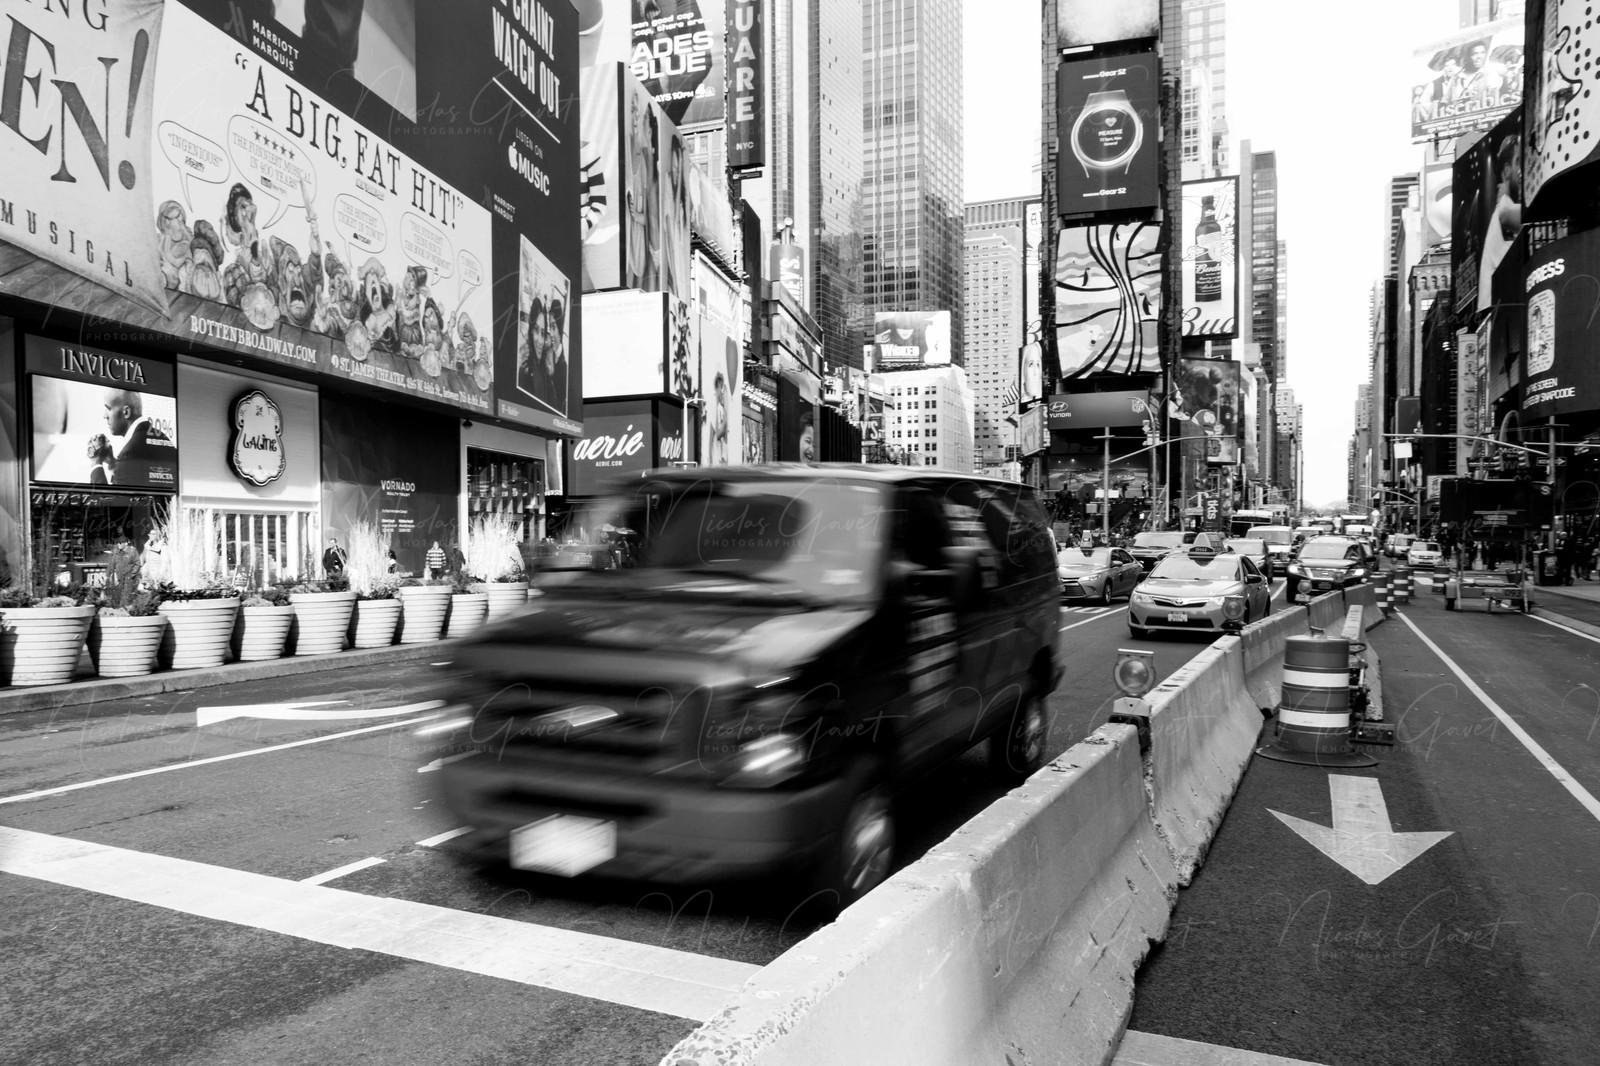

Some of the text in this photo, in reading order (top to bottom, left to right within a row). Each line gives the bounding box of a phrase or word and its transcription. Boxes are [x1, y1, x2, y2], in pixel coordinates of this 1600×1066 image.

[25, 0, 109, 32] NG
[635, 28, 654, 37] cop,
[657, 21, 685, 32] there
[652, 14, 674, 28] good
[676, 12, 695, 22] cop
[252, 20, 300, 60] MARRIOTT
[252, 34, 295, 71] MARQUIS
[493, 6, 560, 119] WATCH OUT
[630, 51, 707, 82] BLUE
[732, 0, 756, 122] UARE
[1098, 68, 1127, 78] Gear S2
[285, 84, 347, 169] BIG,
[354, 129, 401, 196] FAT
[515, 127, 543, 160] LISTEN ON
[735, 141, 754, 151] NYC
[518, 152, 550, 196] MUSIC
[1098, 186, 1127, 196] Gear S2
[0, 198, 133, 288] MUSICAL
[190, 315, 317, 364] ROTTENBROADWAY.COM
[61, 347, 148, 386] INVICTA
[350, 360, 376, 379] JAMES
[573, 424, 645, 461] aerie
[380, 480, 416, 492] VORNADO
[1206, 500, 1219, 520] tkts
[1504, 589, 1522, 598] 093
